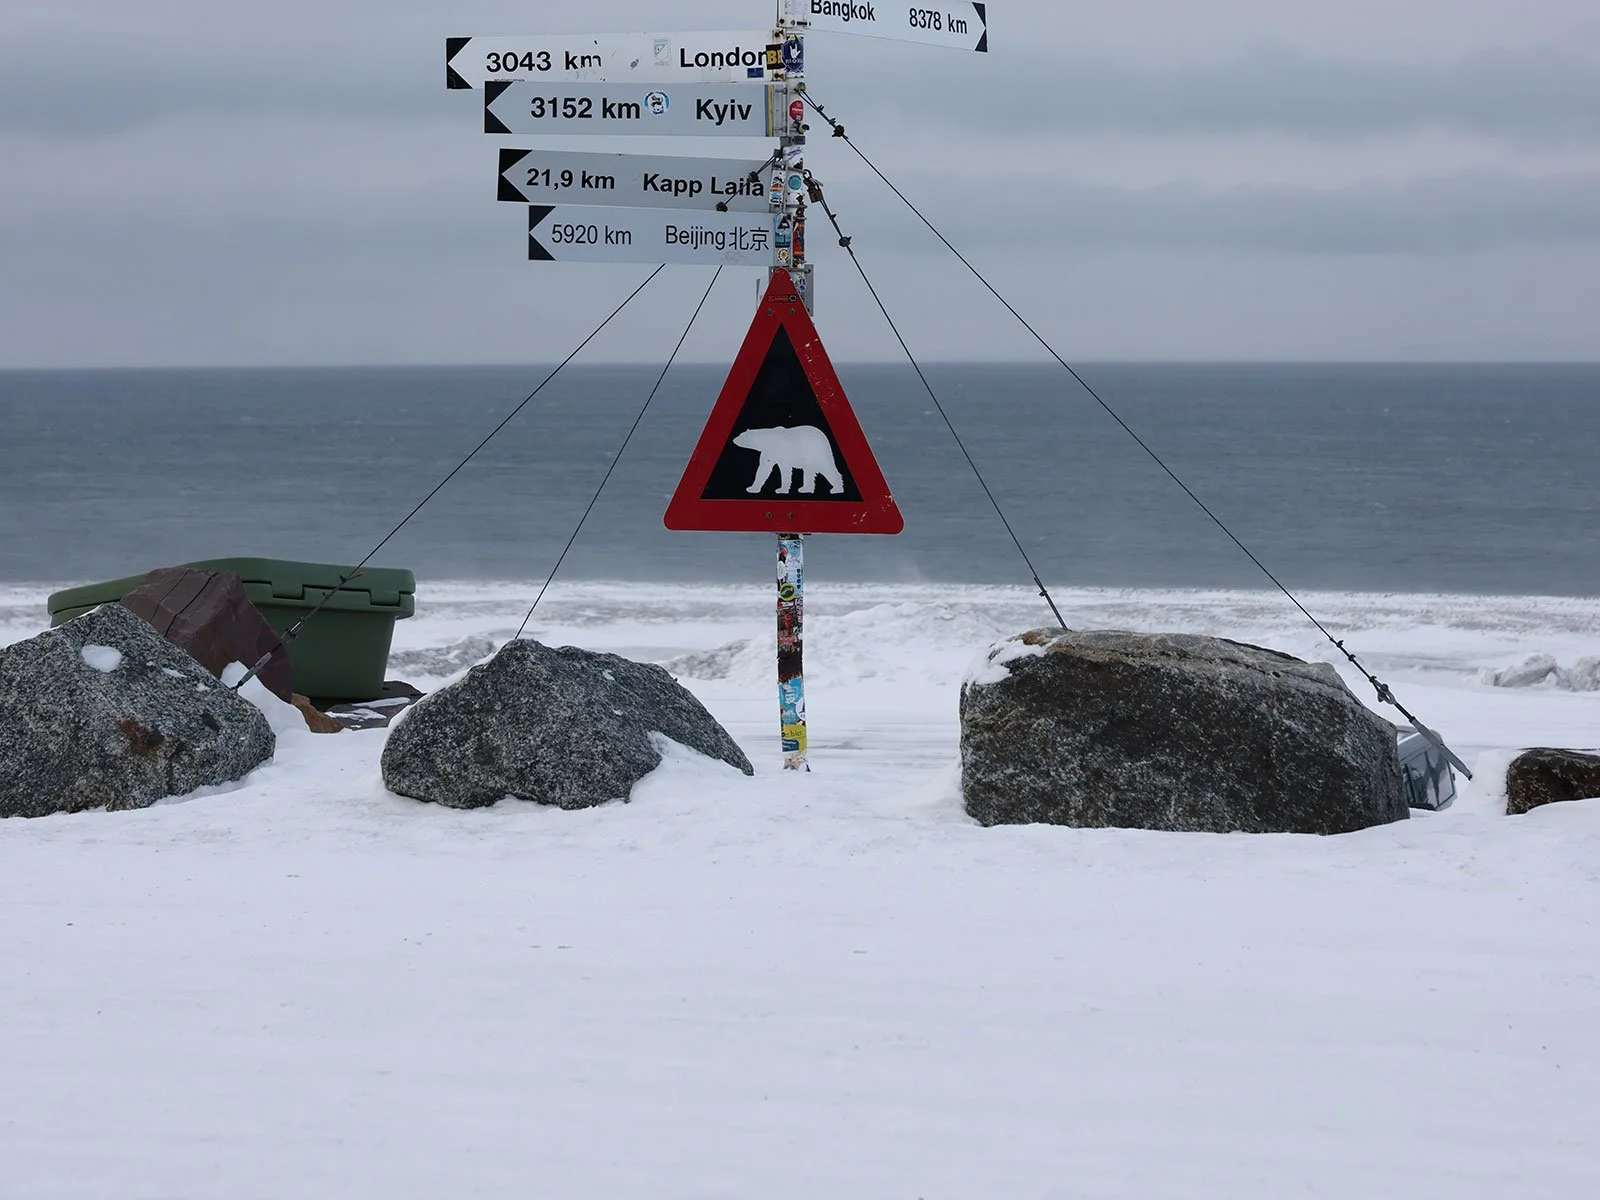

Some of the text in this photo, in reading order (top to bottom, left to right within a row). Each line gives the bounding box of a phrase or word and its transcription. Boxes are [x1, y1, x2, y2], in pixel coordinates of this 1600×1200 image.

[910, 8, 941, 30] 8378
[948, 14, 967, 34] km
[487, 51, 551, 72] 3043
[565, 51, 601, 70] km
[531, 97, 592, 118] 3152
[603, 98, 640, 119] km
[697, 99, 752, 125] Kyiv
[526, 168, 764, 197] 21,9 km Kapp Laila
[552, 224, 597, 244] 5920
[605, 226, 631, 244] km
